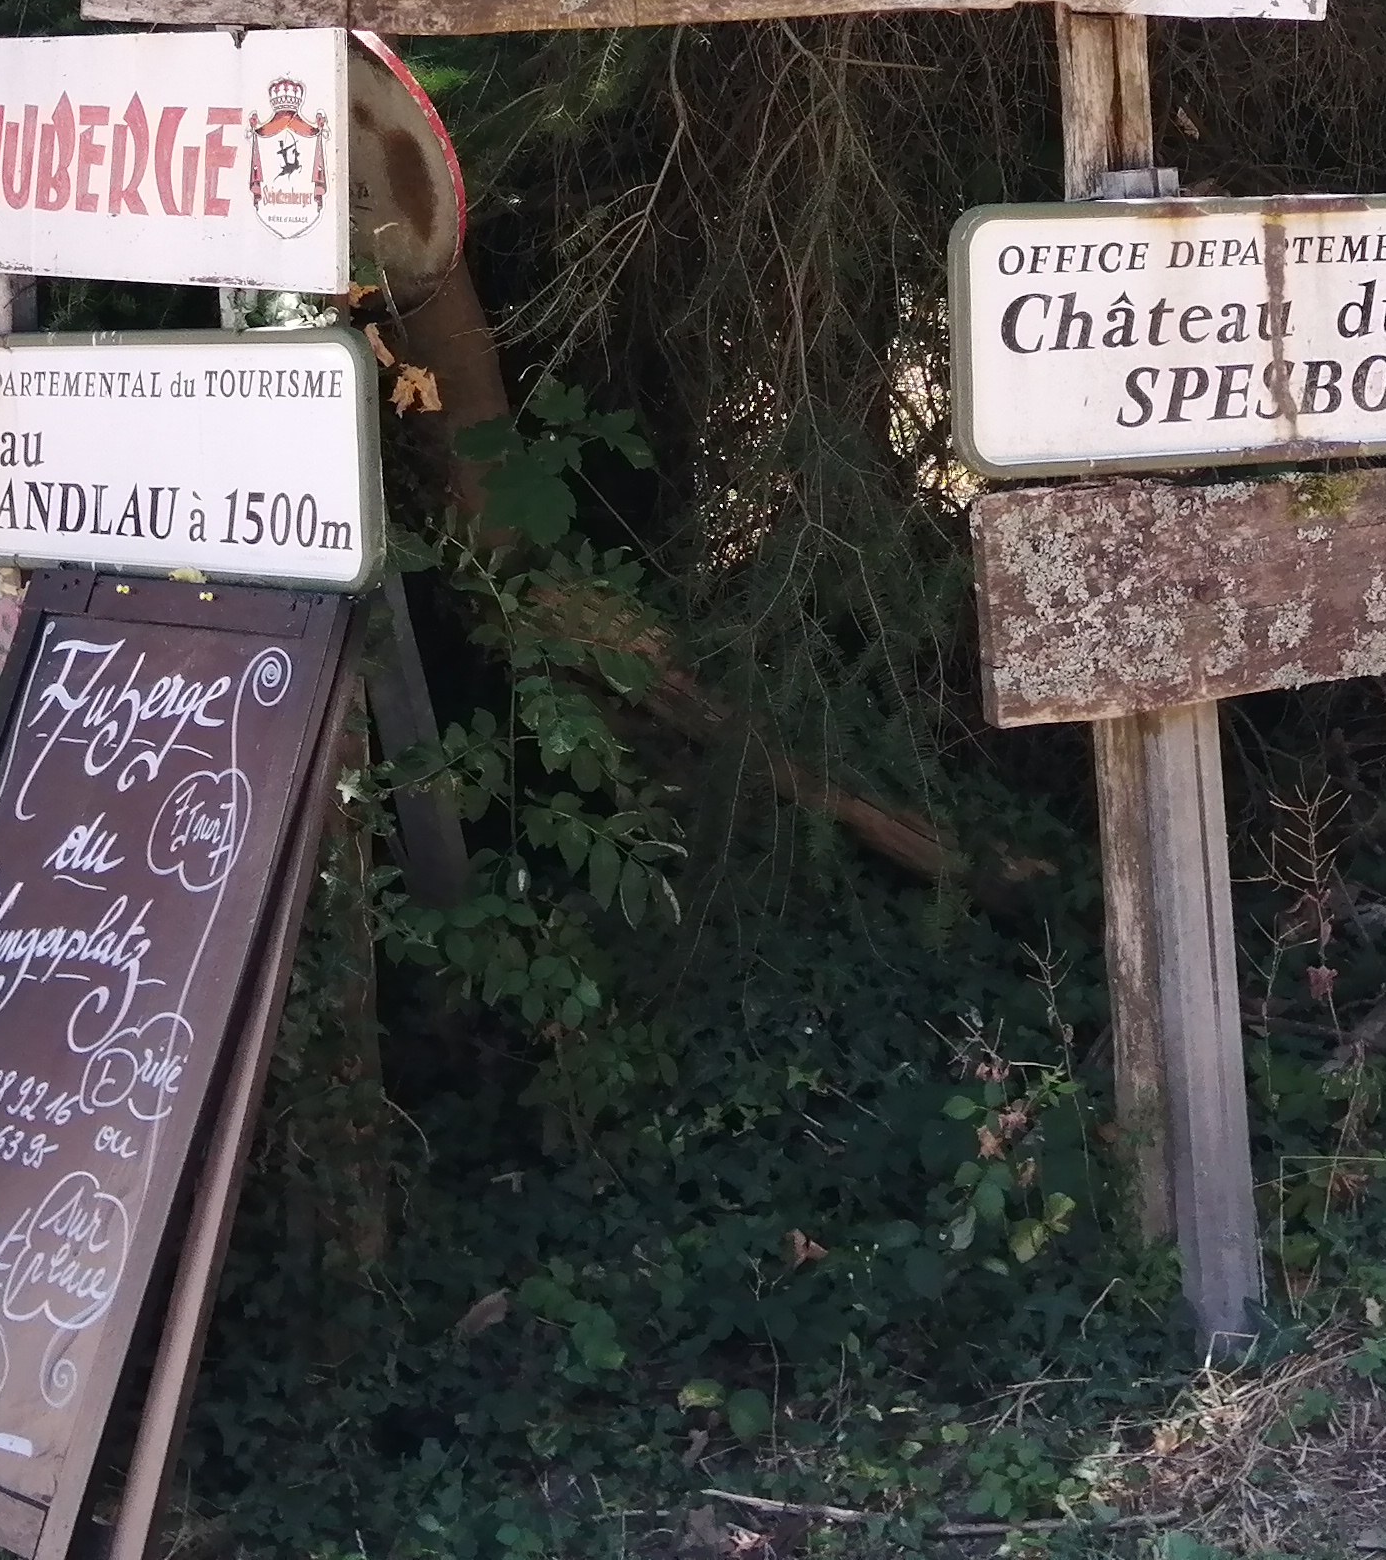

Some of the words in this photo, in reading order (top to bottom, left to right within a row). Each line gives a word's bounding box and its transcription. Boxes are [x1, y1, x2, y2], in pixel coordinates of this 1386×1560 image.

[997, 242, 1149, 276] OFFICE
[1001, 290, 1294, 354] Château
[170, 371, 196, 399] du
[204, 370, 344, 399] TOURISME
[189, 490, 207, 542] à
[219, 488, 353, 550] 1500m
[43, 812, 125, 873] du
[95, 1124, 138, 1158] ou
